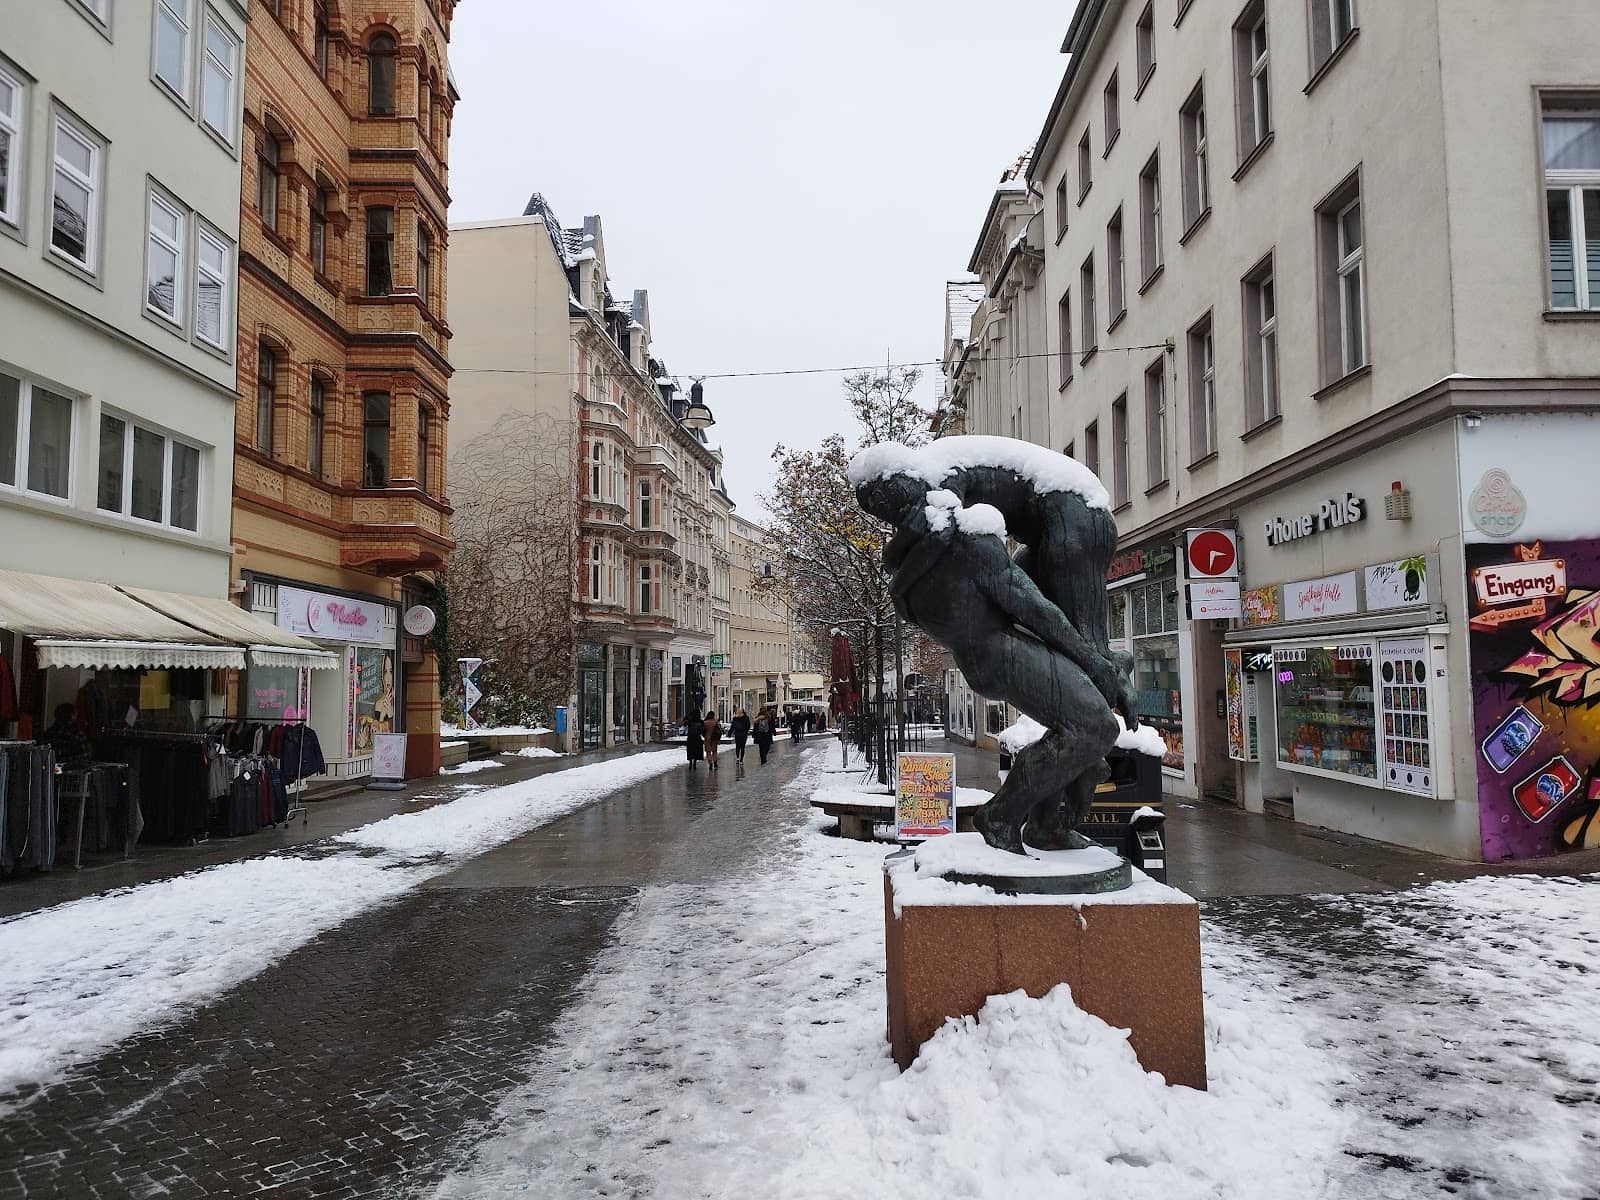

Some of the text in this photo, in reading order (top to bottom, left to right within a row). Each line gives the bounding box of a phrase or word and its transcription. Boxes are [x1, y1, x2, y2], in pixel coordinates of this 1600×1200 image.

[1263, 491, 1361, 546] Phone Puls
[1480, 514, 1516, 527] shop
[1485, 574, 1556, 598] Eingang
[899, 759, 934, 776] Candy
[1083, 813, 1120, 823] FALL
